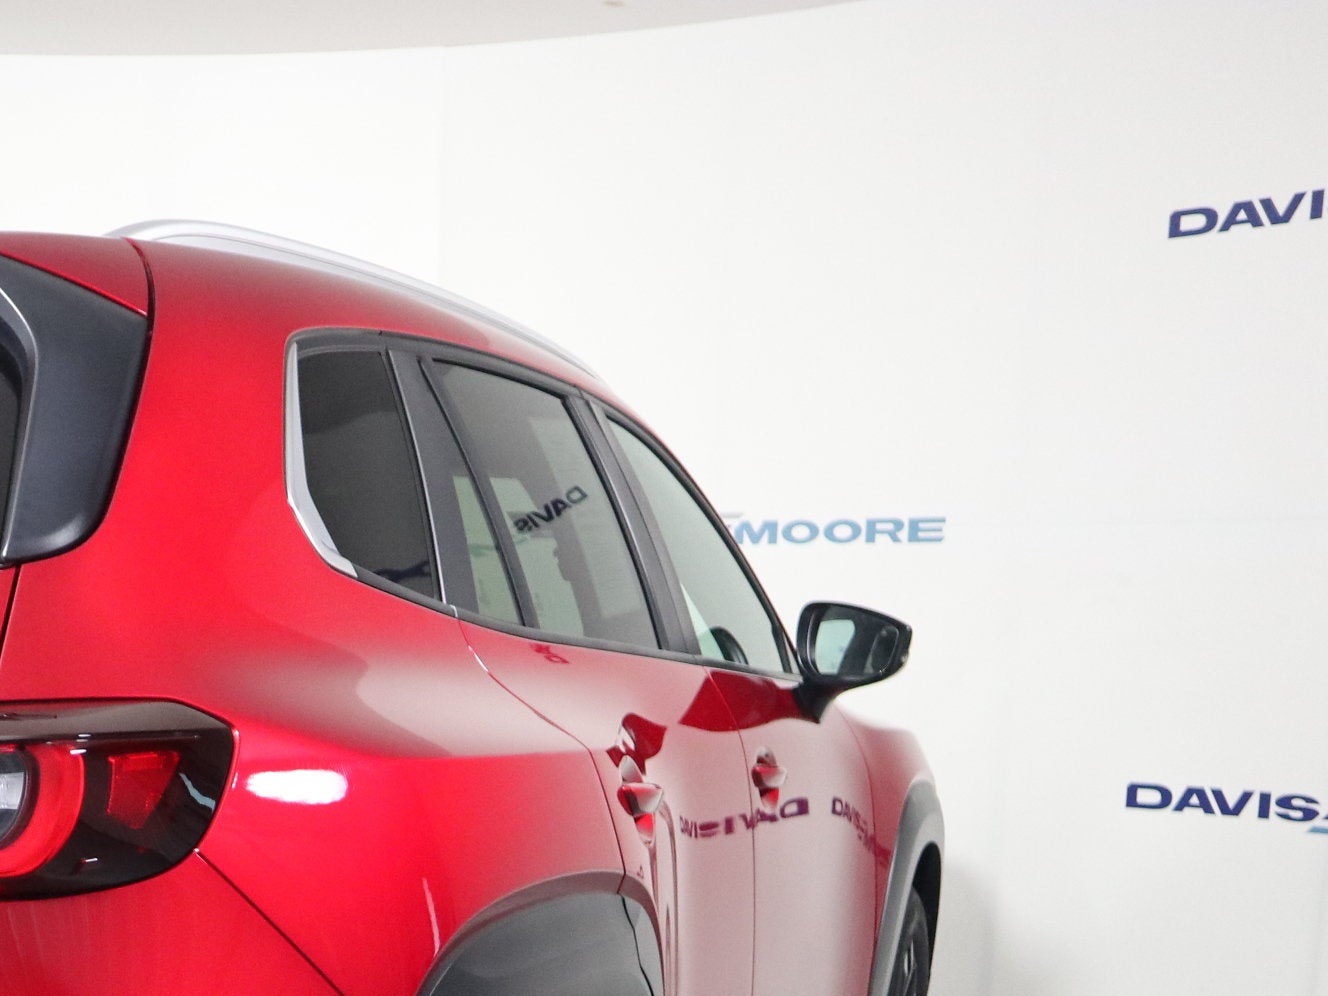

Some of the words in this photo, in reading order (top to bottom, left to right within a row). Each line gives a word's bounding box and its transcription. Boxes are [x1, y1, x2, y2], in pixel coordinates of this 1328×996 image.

[1168, 188, 1328, 239] DAVI
[732, 516, 947, 545] MOORE
[1125, 781, 1321, 822] DAVIS
